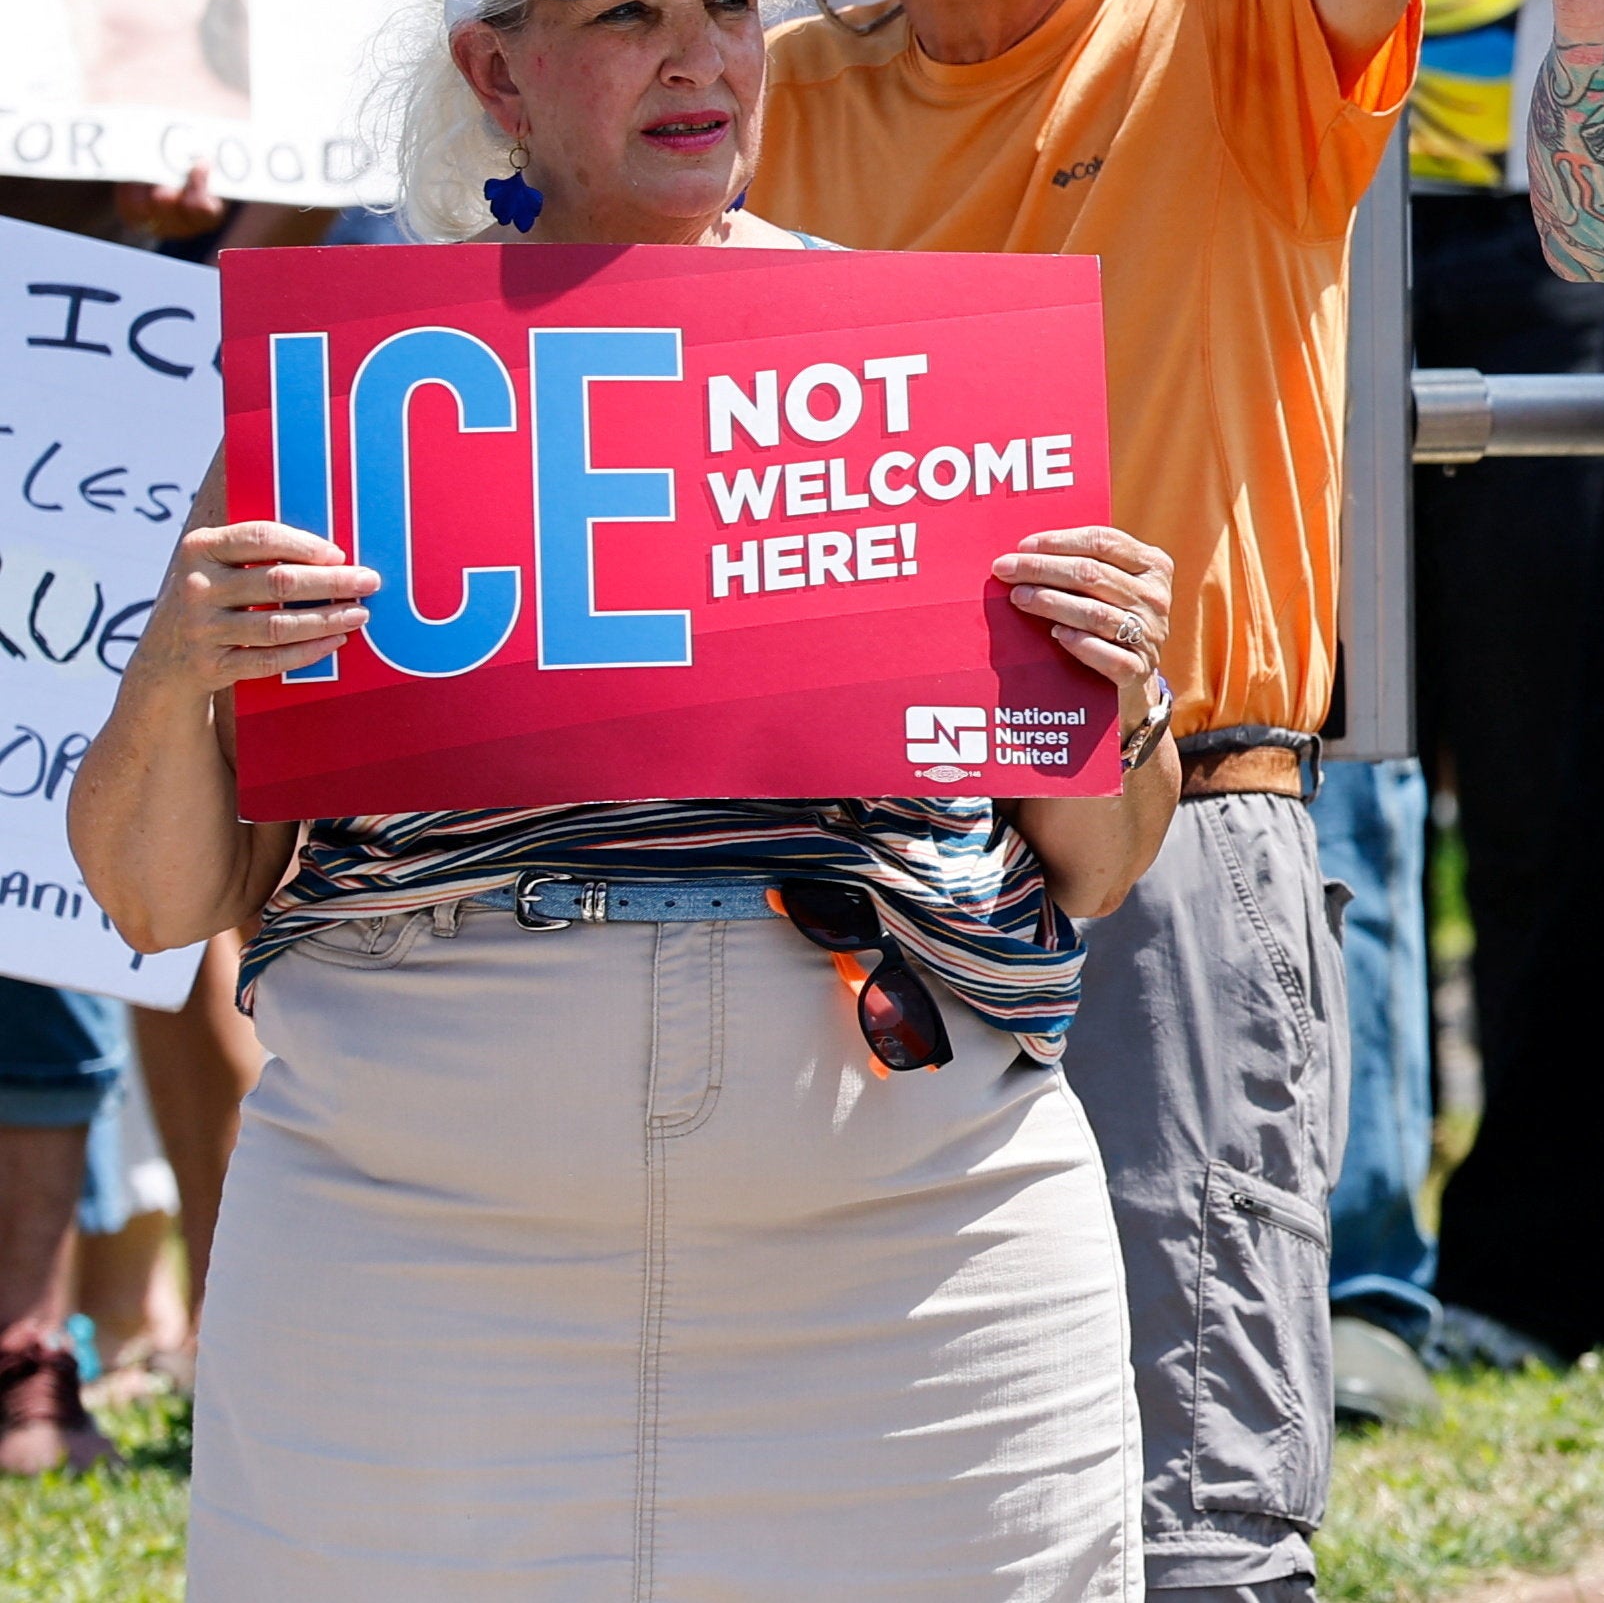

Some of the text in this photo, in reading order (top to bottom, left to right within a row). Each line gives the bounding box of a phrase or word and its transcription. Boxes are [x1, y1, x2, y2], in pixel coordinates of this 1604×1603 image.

[0, 107, 105, 168] OR
[27, 282, 222, 379] IC
[708, 353, 929, 453] NOT
[269, 326, 693, 684] ICE
[707, 434, 1074, 524] WELCOME
[711, 523, 918, 598] HERE!
[994, 707, 1086, 725] National
[995, 727, 1070, 745] Nurses
[995, 747, 1069, 765] United
